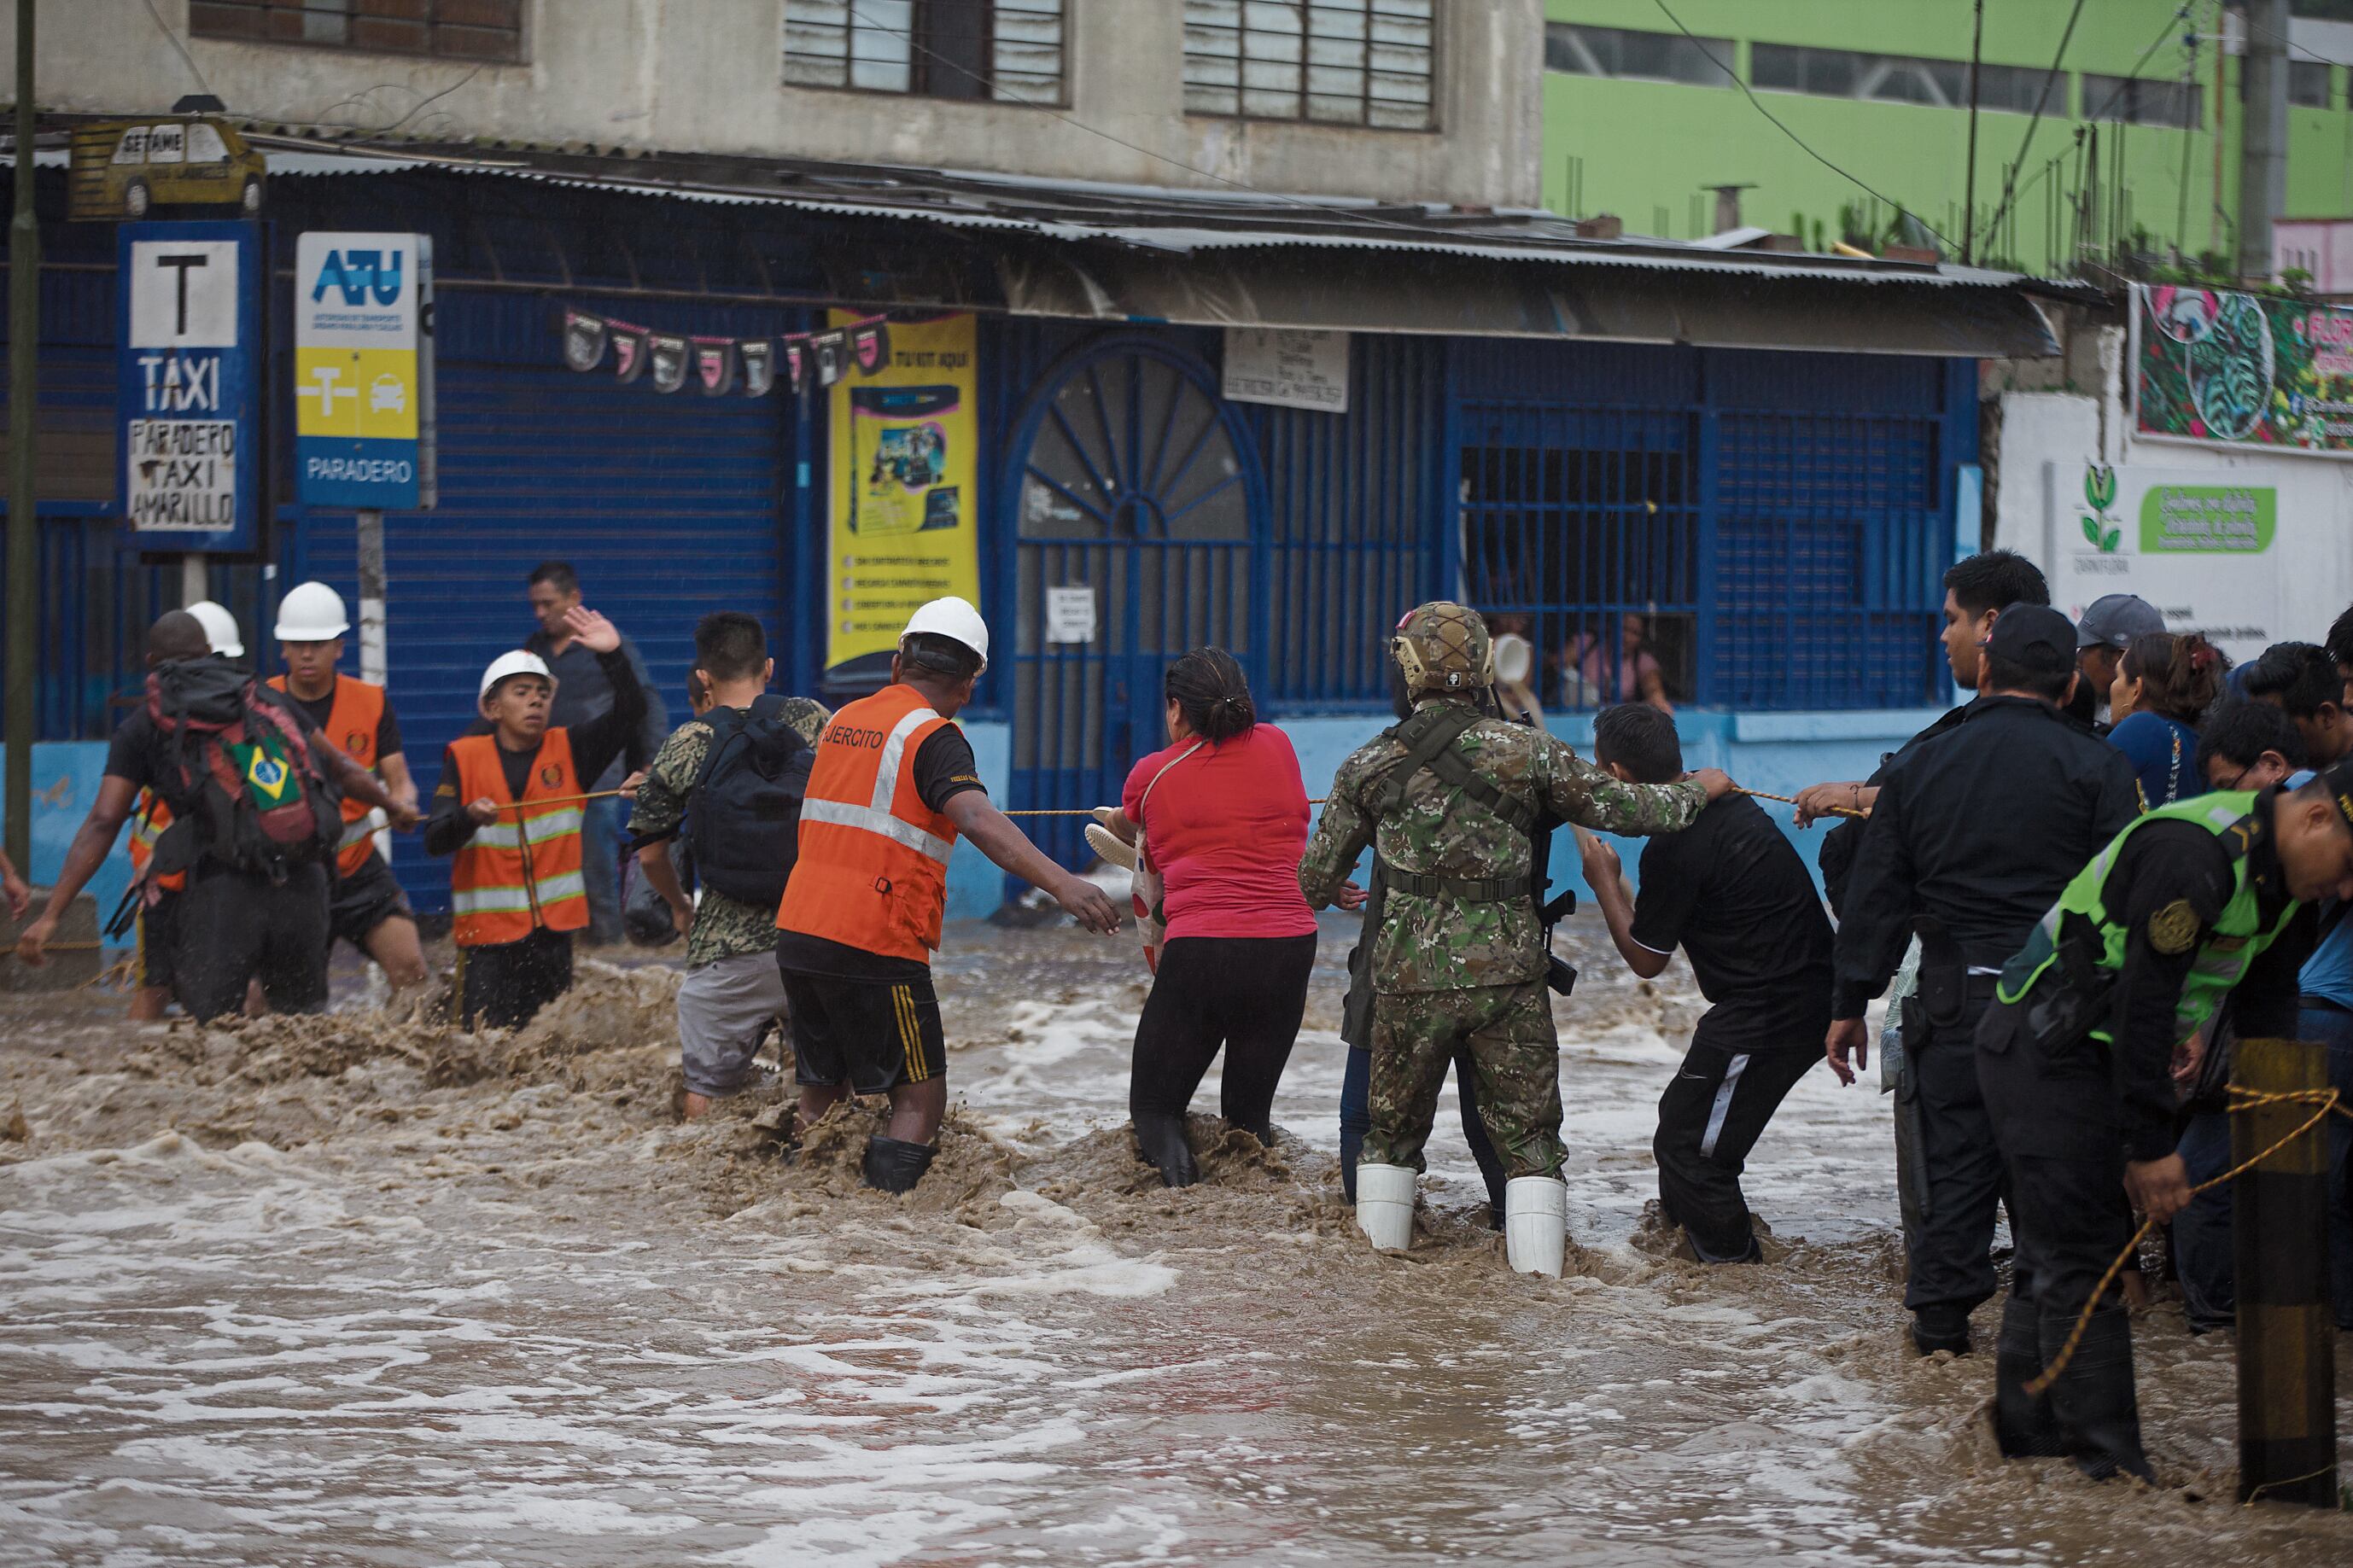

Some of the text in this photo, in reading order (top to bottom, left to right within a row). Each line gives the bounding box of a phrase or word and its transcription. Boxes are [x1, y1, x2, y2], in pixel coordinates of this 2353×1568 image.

[312, 250, 402, 306] ATU
[158, 254, 207, 335] T
[137, 357, 219, 411] TAXI
[133, 424, 233, 455] PARADERO
[141, 459, 214, 489] TAXI
[307, 457, 412, 483] PARADERO
[134, 493, 232, 525] AMARILLO
